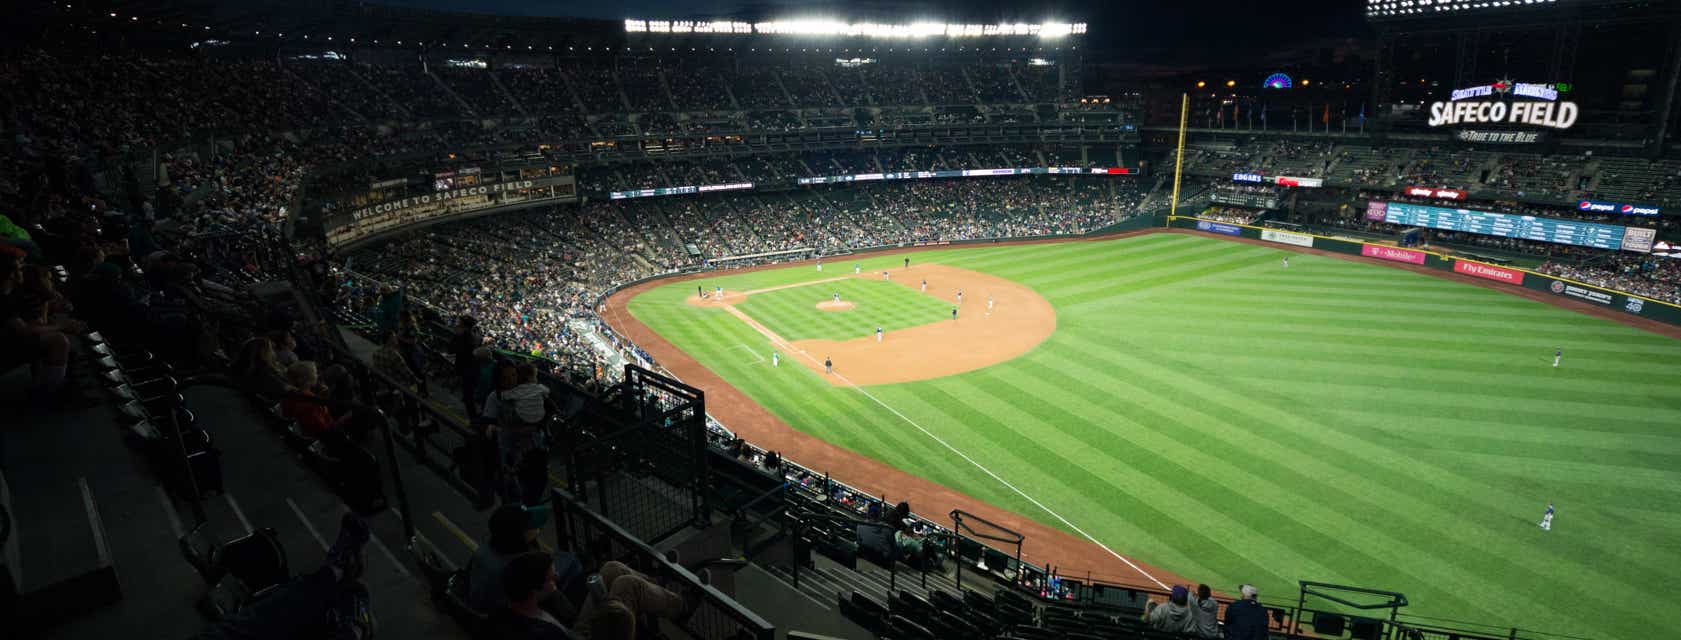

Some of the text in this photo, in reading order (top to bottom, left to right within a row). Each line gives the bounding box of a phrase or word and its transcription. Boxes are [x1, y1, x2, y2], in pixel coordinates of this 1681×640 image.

[1428, 101, 1579, 129] SAFECO FIELD
[353, 180, 533, 220] WELCOME TO SAFECO FIELD
[1590, 203, 1615, 212] pepsi
[1632, 207, 1659, 215] pepsi
[1463, 263, 1513, 279] Fly Emirates
